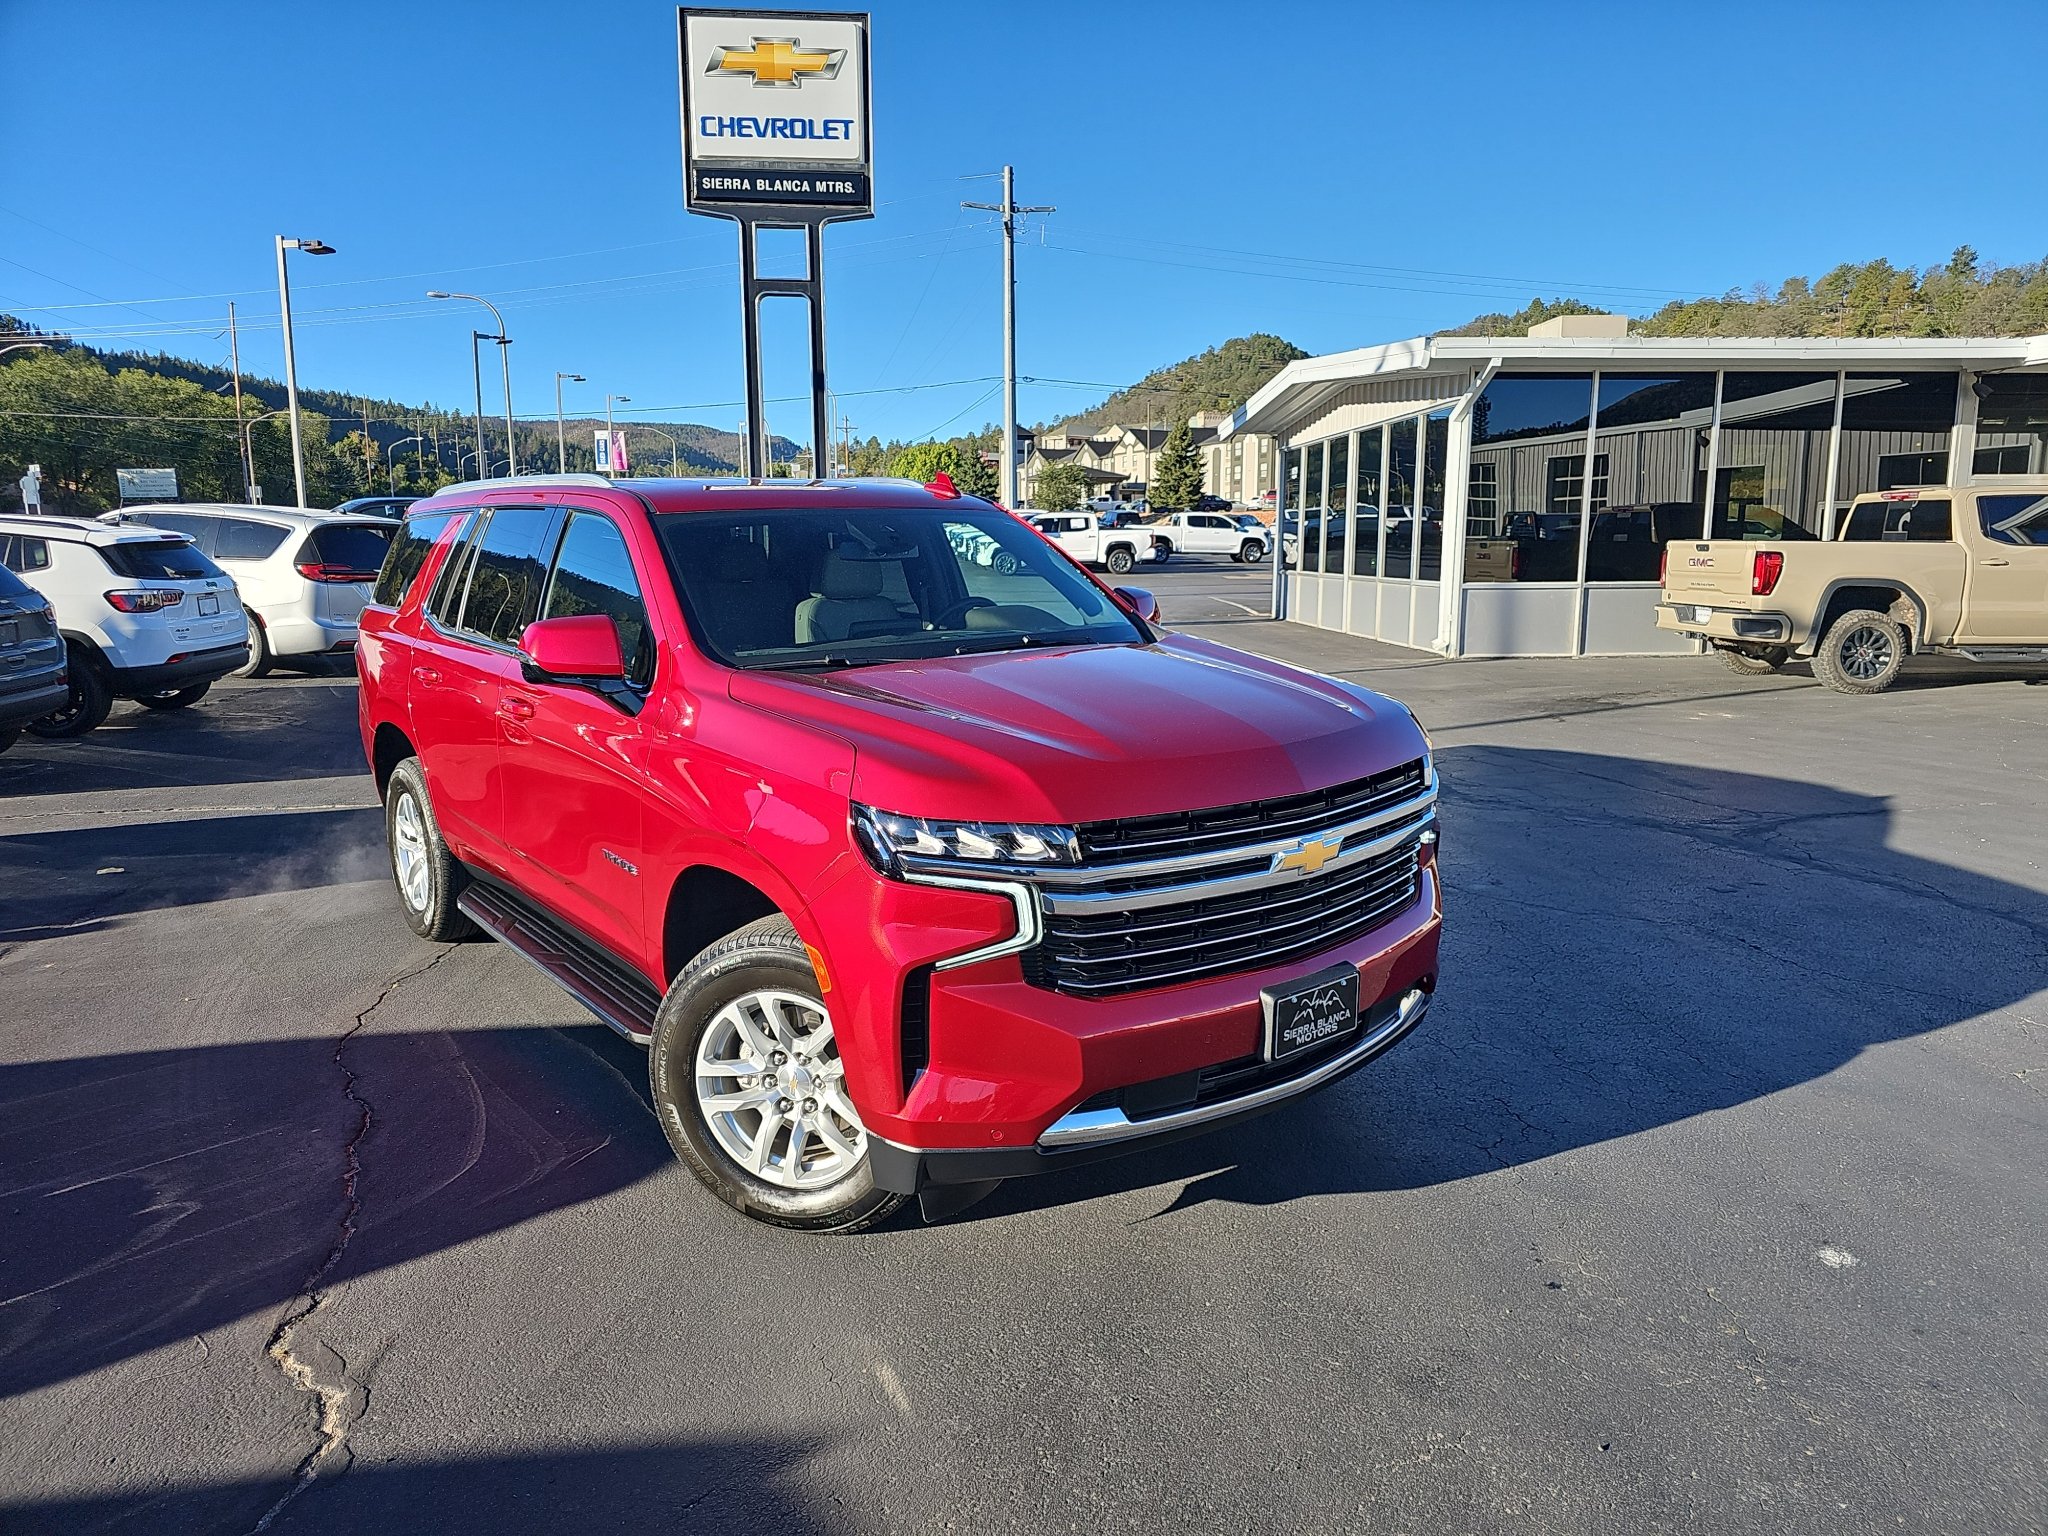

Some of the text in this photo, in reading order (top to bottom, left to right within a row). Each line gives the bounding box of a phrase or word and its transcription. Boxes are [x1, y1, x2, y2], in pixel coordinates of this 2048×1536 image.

[700, 116, 854, 140] CHEVROLET
[702, 177, 855, 194] SIERRA BLANCA MTRS.
[1688, 558, 1715, 567] GMC
[1283, 1009, 1351, 1041] SIERRA BLANCA
[1296, 1022, 1338, 1046] MOTORS
[659, 1043, 668, 1093] PRIMACY
